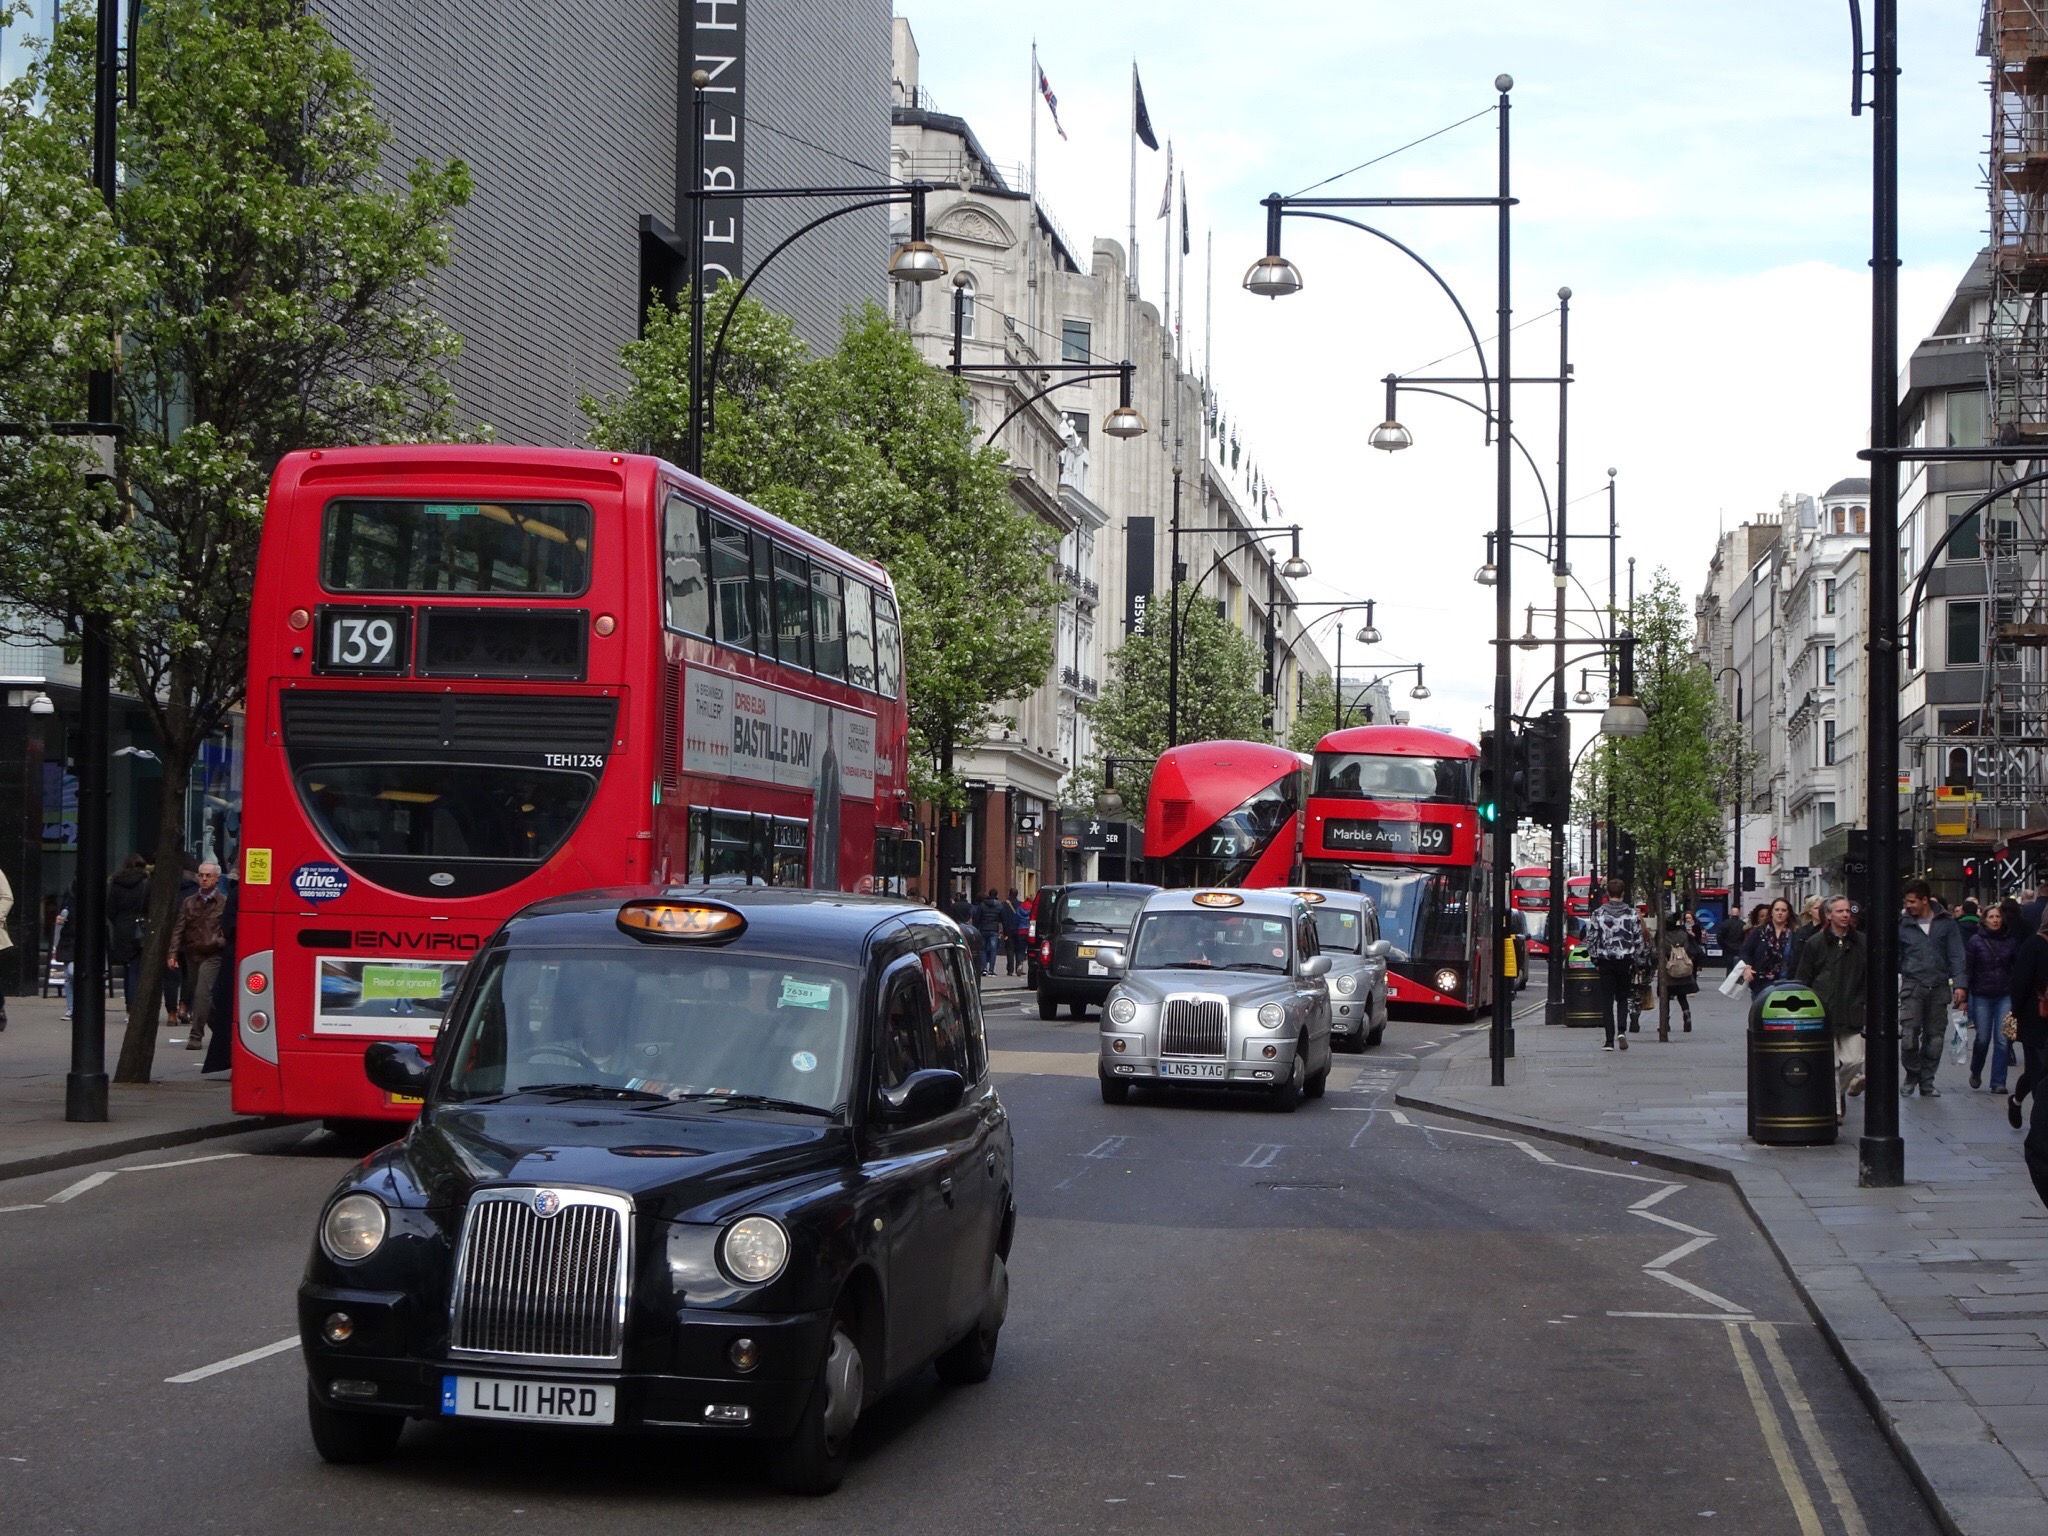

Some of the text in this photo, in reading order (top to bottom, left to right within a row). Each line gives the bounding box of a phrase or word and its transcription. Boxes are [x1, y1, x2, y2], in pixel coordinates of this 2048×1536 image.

[332, 619, 394, 664] 139
[733, 715, 812, 768] BASTILLE DAY
[544, 754, 604, 768] TEH1236
[1106, 834, 1118, 843] SER
[1212, 836, 1236, 855] 73
[1333, 828, 1444, 848] Marble Arch 159
[295, 871, 347, 888] drive...
[641, 908, 716, 929] TAXI
[355, 930, 491, 951] ENVIRO
[373, 977, 437, 989] Read or ignore?
[786, 987, 813, 997] 76381
[1168, 1064, 1223, 1076] LN63 YAG
[537, 1386, 597, 1417] HRD
